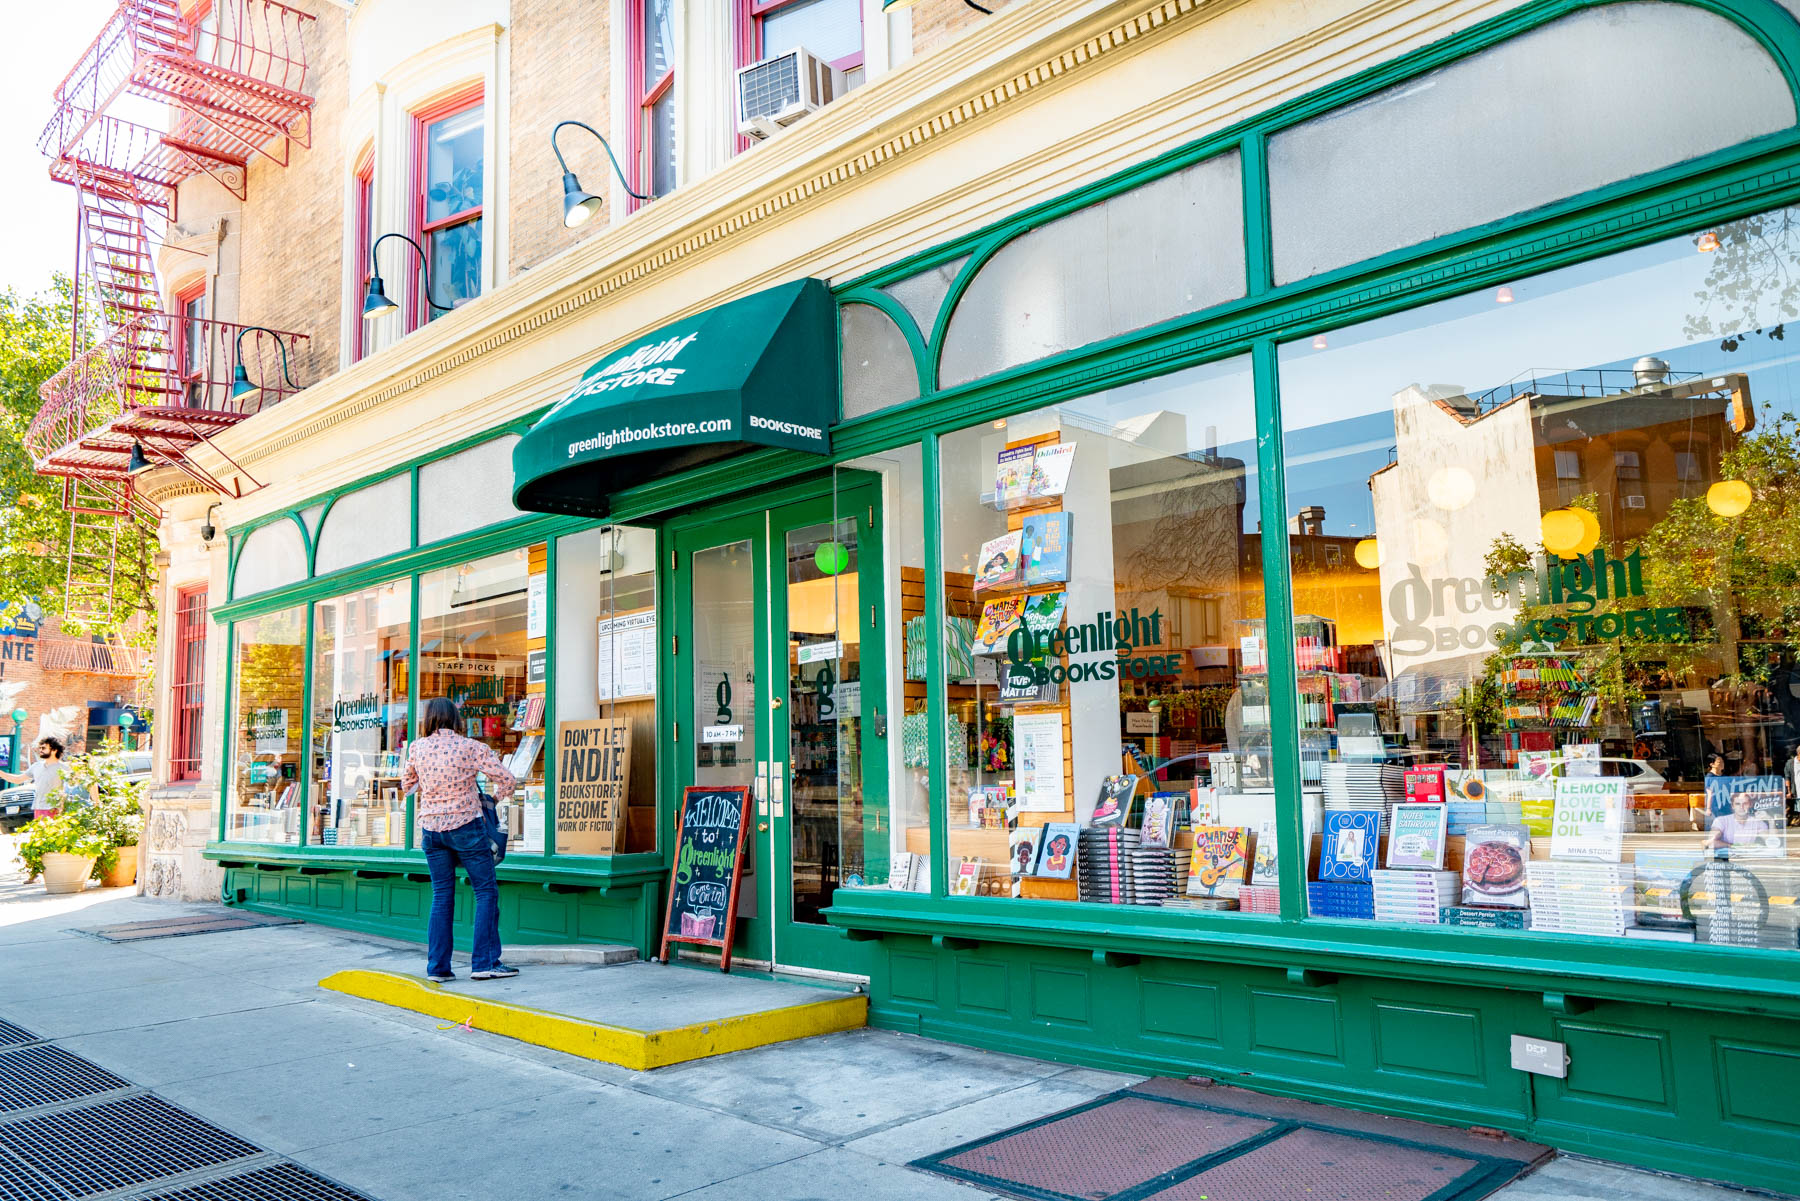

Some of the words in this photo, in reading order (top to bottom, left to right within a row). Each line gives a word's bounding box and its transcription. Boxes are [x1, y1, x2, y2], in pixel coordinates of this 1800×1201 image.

[749, 415, 822, 439] BOOKSTORE
[569, 419, 731, 458] greenlightbookstore.com
[1037, 445, 1073, 458] Oddbird
[985, 599, 1019, 617] CHANGE
[1388, 545, 1649, 656] greenlight
[601, 620, 626, 632] UPCOMING
[627, 617, 646, 626] VIRTUAL
[1434, 606, 1686, 652] BOOKSTORE
[1007, 606, 1164, 689] greenlight
[437, 662, 464, 670] STAFF
[468, 664, 495, 672] PICKS
[1036, 653, 1183, 686] BOOKSTORE
[816, 658, 834, 715] g
[1001, 686, 1039, 698] MATTER
[717, 672, 732, 725] g
[334, 692, 378, 733] greenlight
[341, 717, 382, 732] BOOKSTORE
[564, 728, 601, 747] DON'T
[603, 726, 627, 746] LET
[714, 730, 721, 738] AM
[561, 747, 625, 783] INDIE
[560, 783, 623, 799] BOOKSTORES
[1561, 783, 1618, 794] LEMON
[1709, 775, 1779, 810] ANTONI
[558, 800, 609, 819] BECOME
[1560, 796, 1600, 809] LOVE
[684, 795, 741, 830] WELCOME
[1401, 811, 1424, 821] NOTES
[1558, 810, 1606, 823] OLIVE
[557, 821, 577, 832] WORK
[578, 821, 588, 832] OF
[1329, 813, 1376, 835] COOK
[1399, 820, 1437, 829] BATHROOM
[1472, 827, 1498, 836] Dessert
[1498, 829, 1519, 837] Person
[1557, 824, 1583, 837] OIL
[702, 828, 715, 843] to
[1196, 830, 1241, 848] CHANGE
[1418, 829, 1433, 838] LINE
[676, 836, 735, 885] greenlight
[1203, 843, 1235, 860] Sings
[1324, 855, 1371, 879] BOOK
[689, 884, 710, 902] Come
[710, 887, 725, 907] in!
